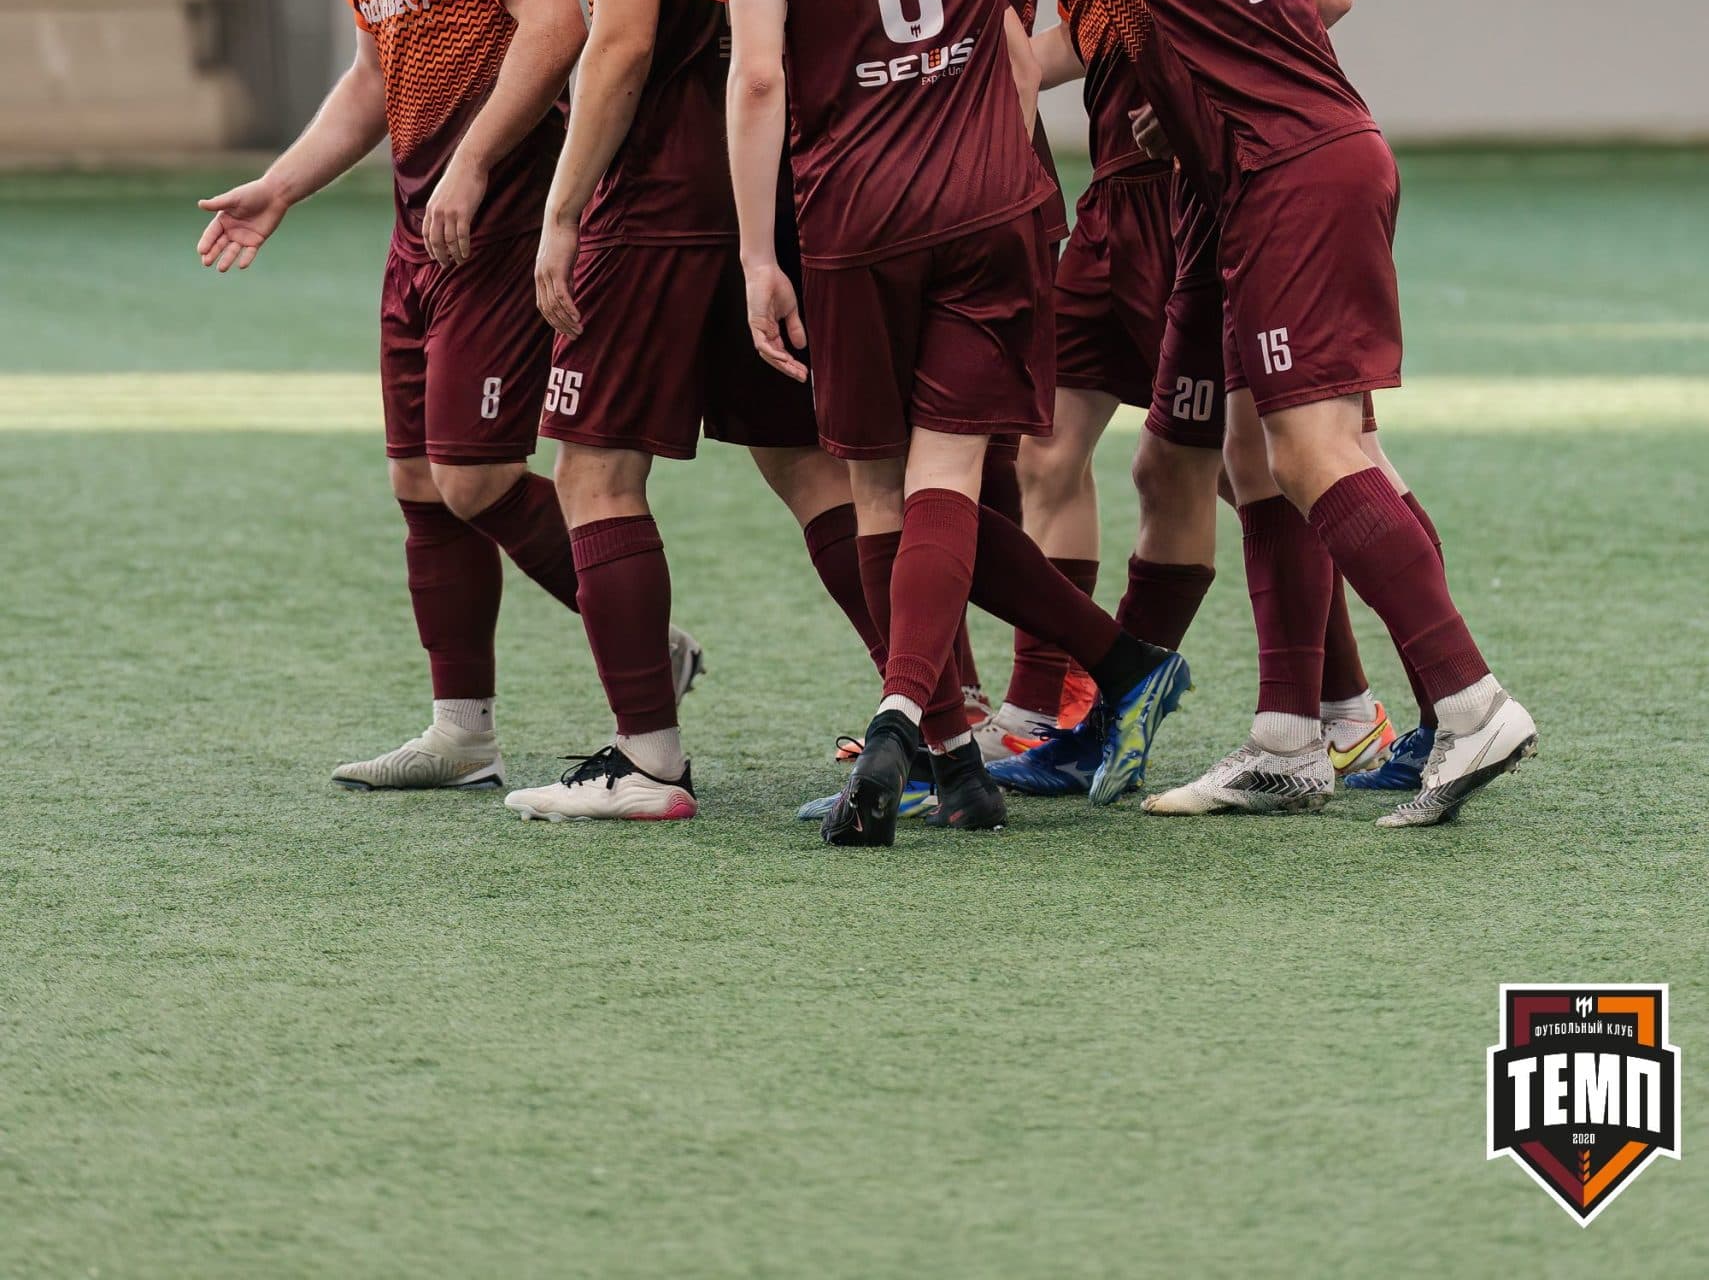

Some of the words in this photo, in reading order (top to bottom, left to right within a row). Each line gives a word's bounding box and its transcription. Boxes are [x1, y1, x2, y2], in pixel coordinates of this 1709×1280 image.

[855, 37, 975, 87] SEUS
[1257, 327, 1293, 375] 15
[481, 376, 502, 419] 8
[545, 366, 583, 416] 55
[1172, 376, 1214, 421] 20
